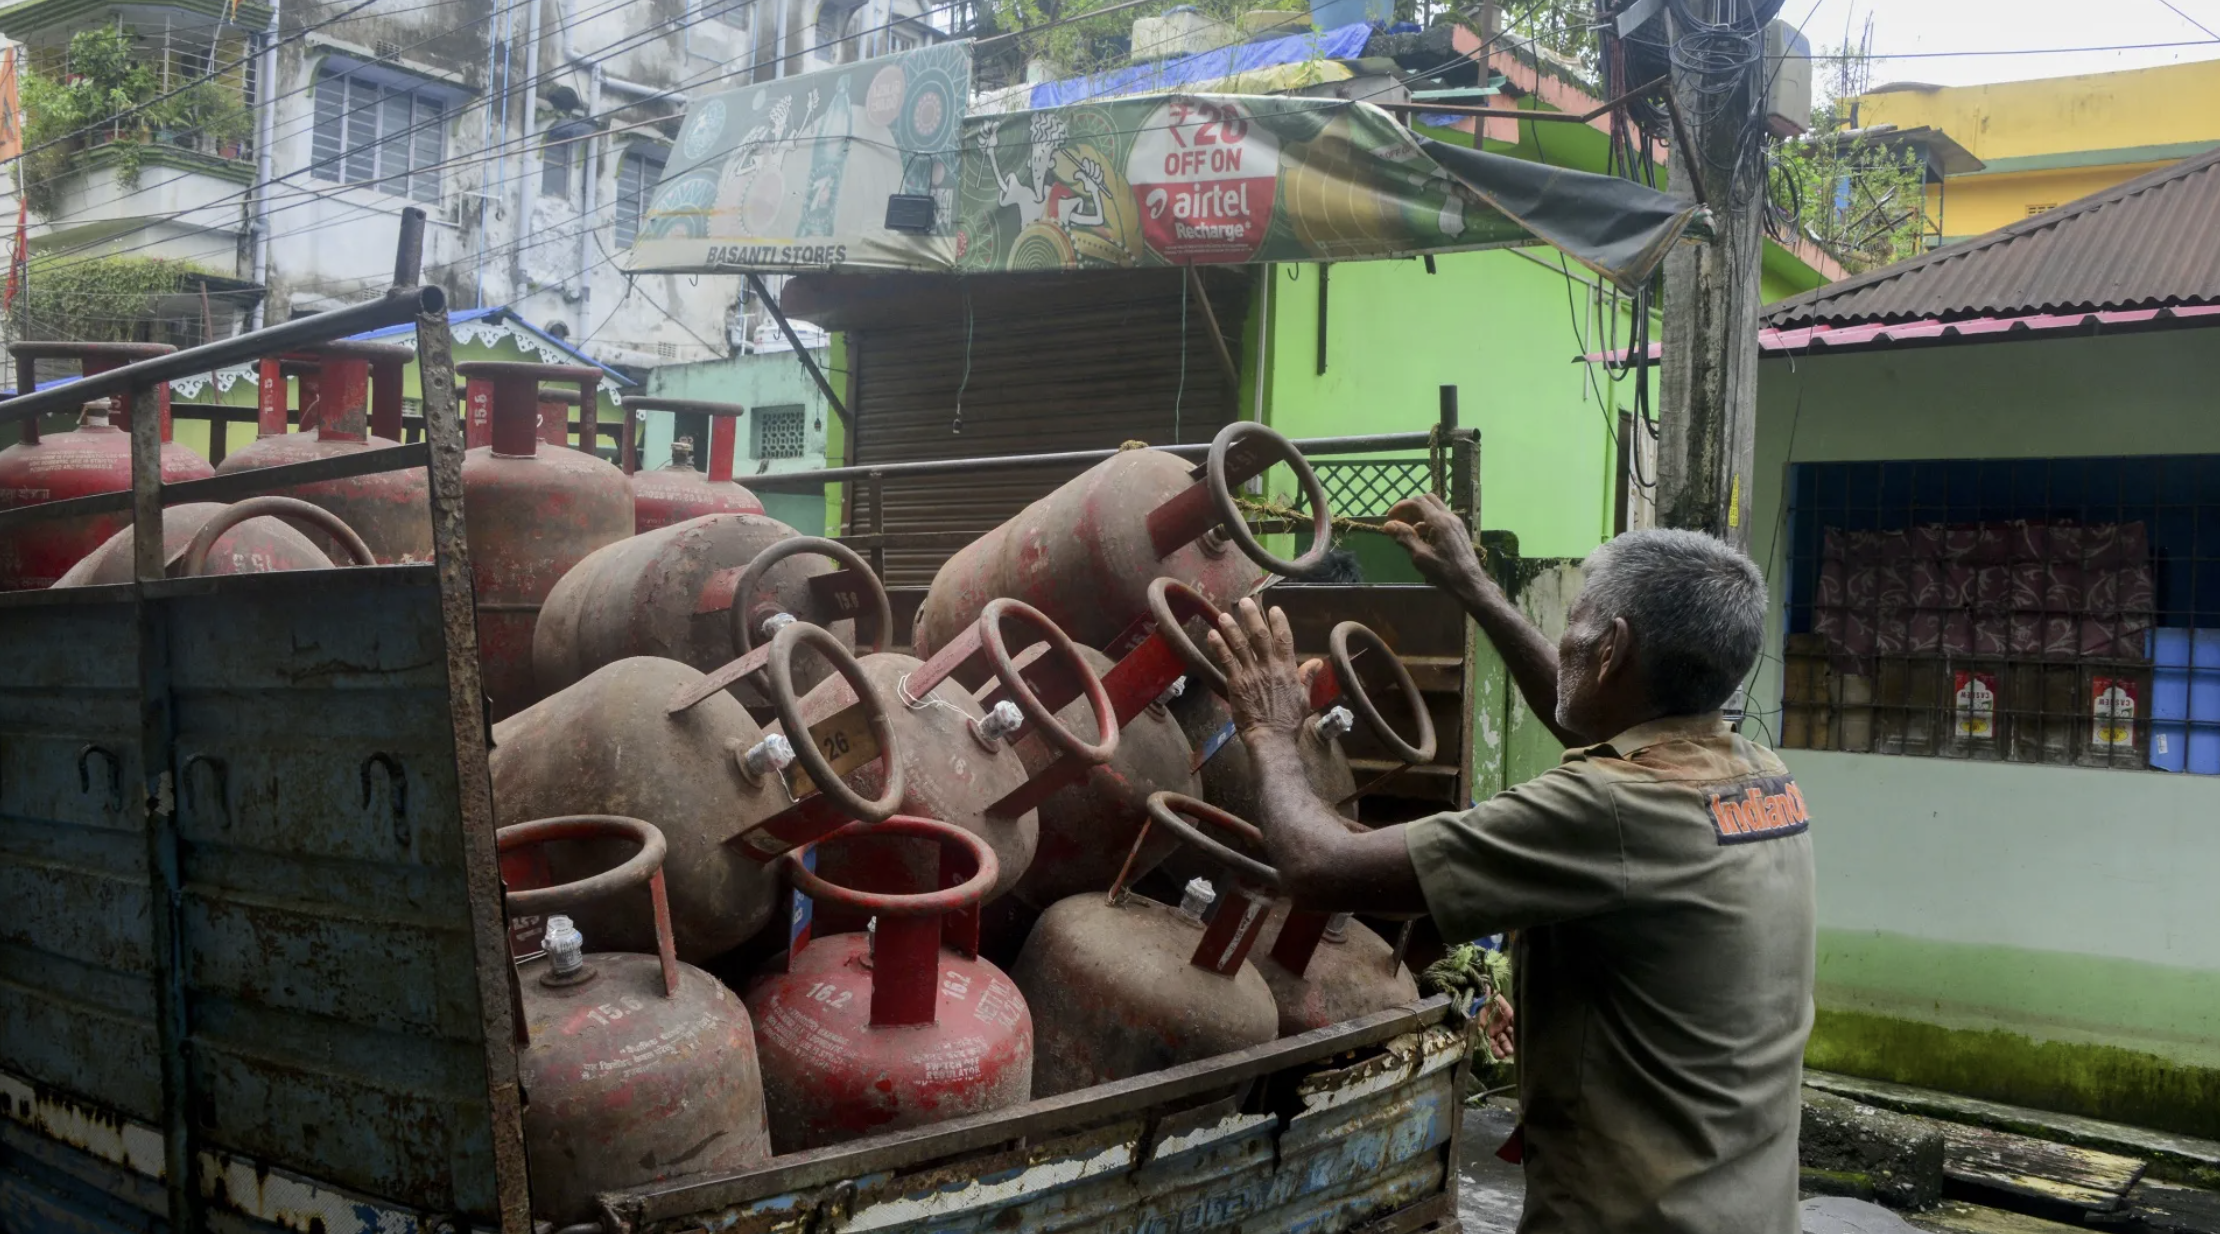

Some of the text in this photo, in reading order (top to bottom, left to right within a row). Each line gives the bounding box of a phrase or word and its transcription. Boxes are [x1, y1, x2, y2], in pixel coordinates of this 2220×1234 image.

[1164, 148, 1242, 176] OFF ON
[1173, 182, 1250, 219] airtel
[706, 244, 846, 264] BASANTI STORES
[823, 732, 849, 761] 26
[806, 982, 853, 1008] 16.2
[941, 970, 971, 1000] 16.2
[925, 1062, 962, 1071] SWTCH
